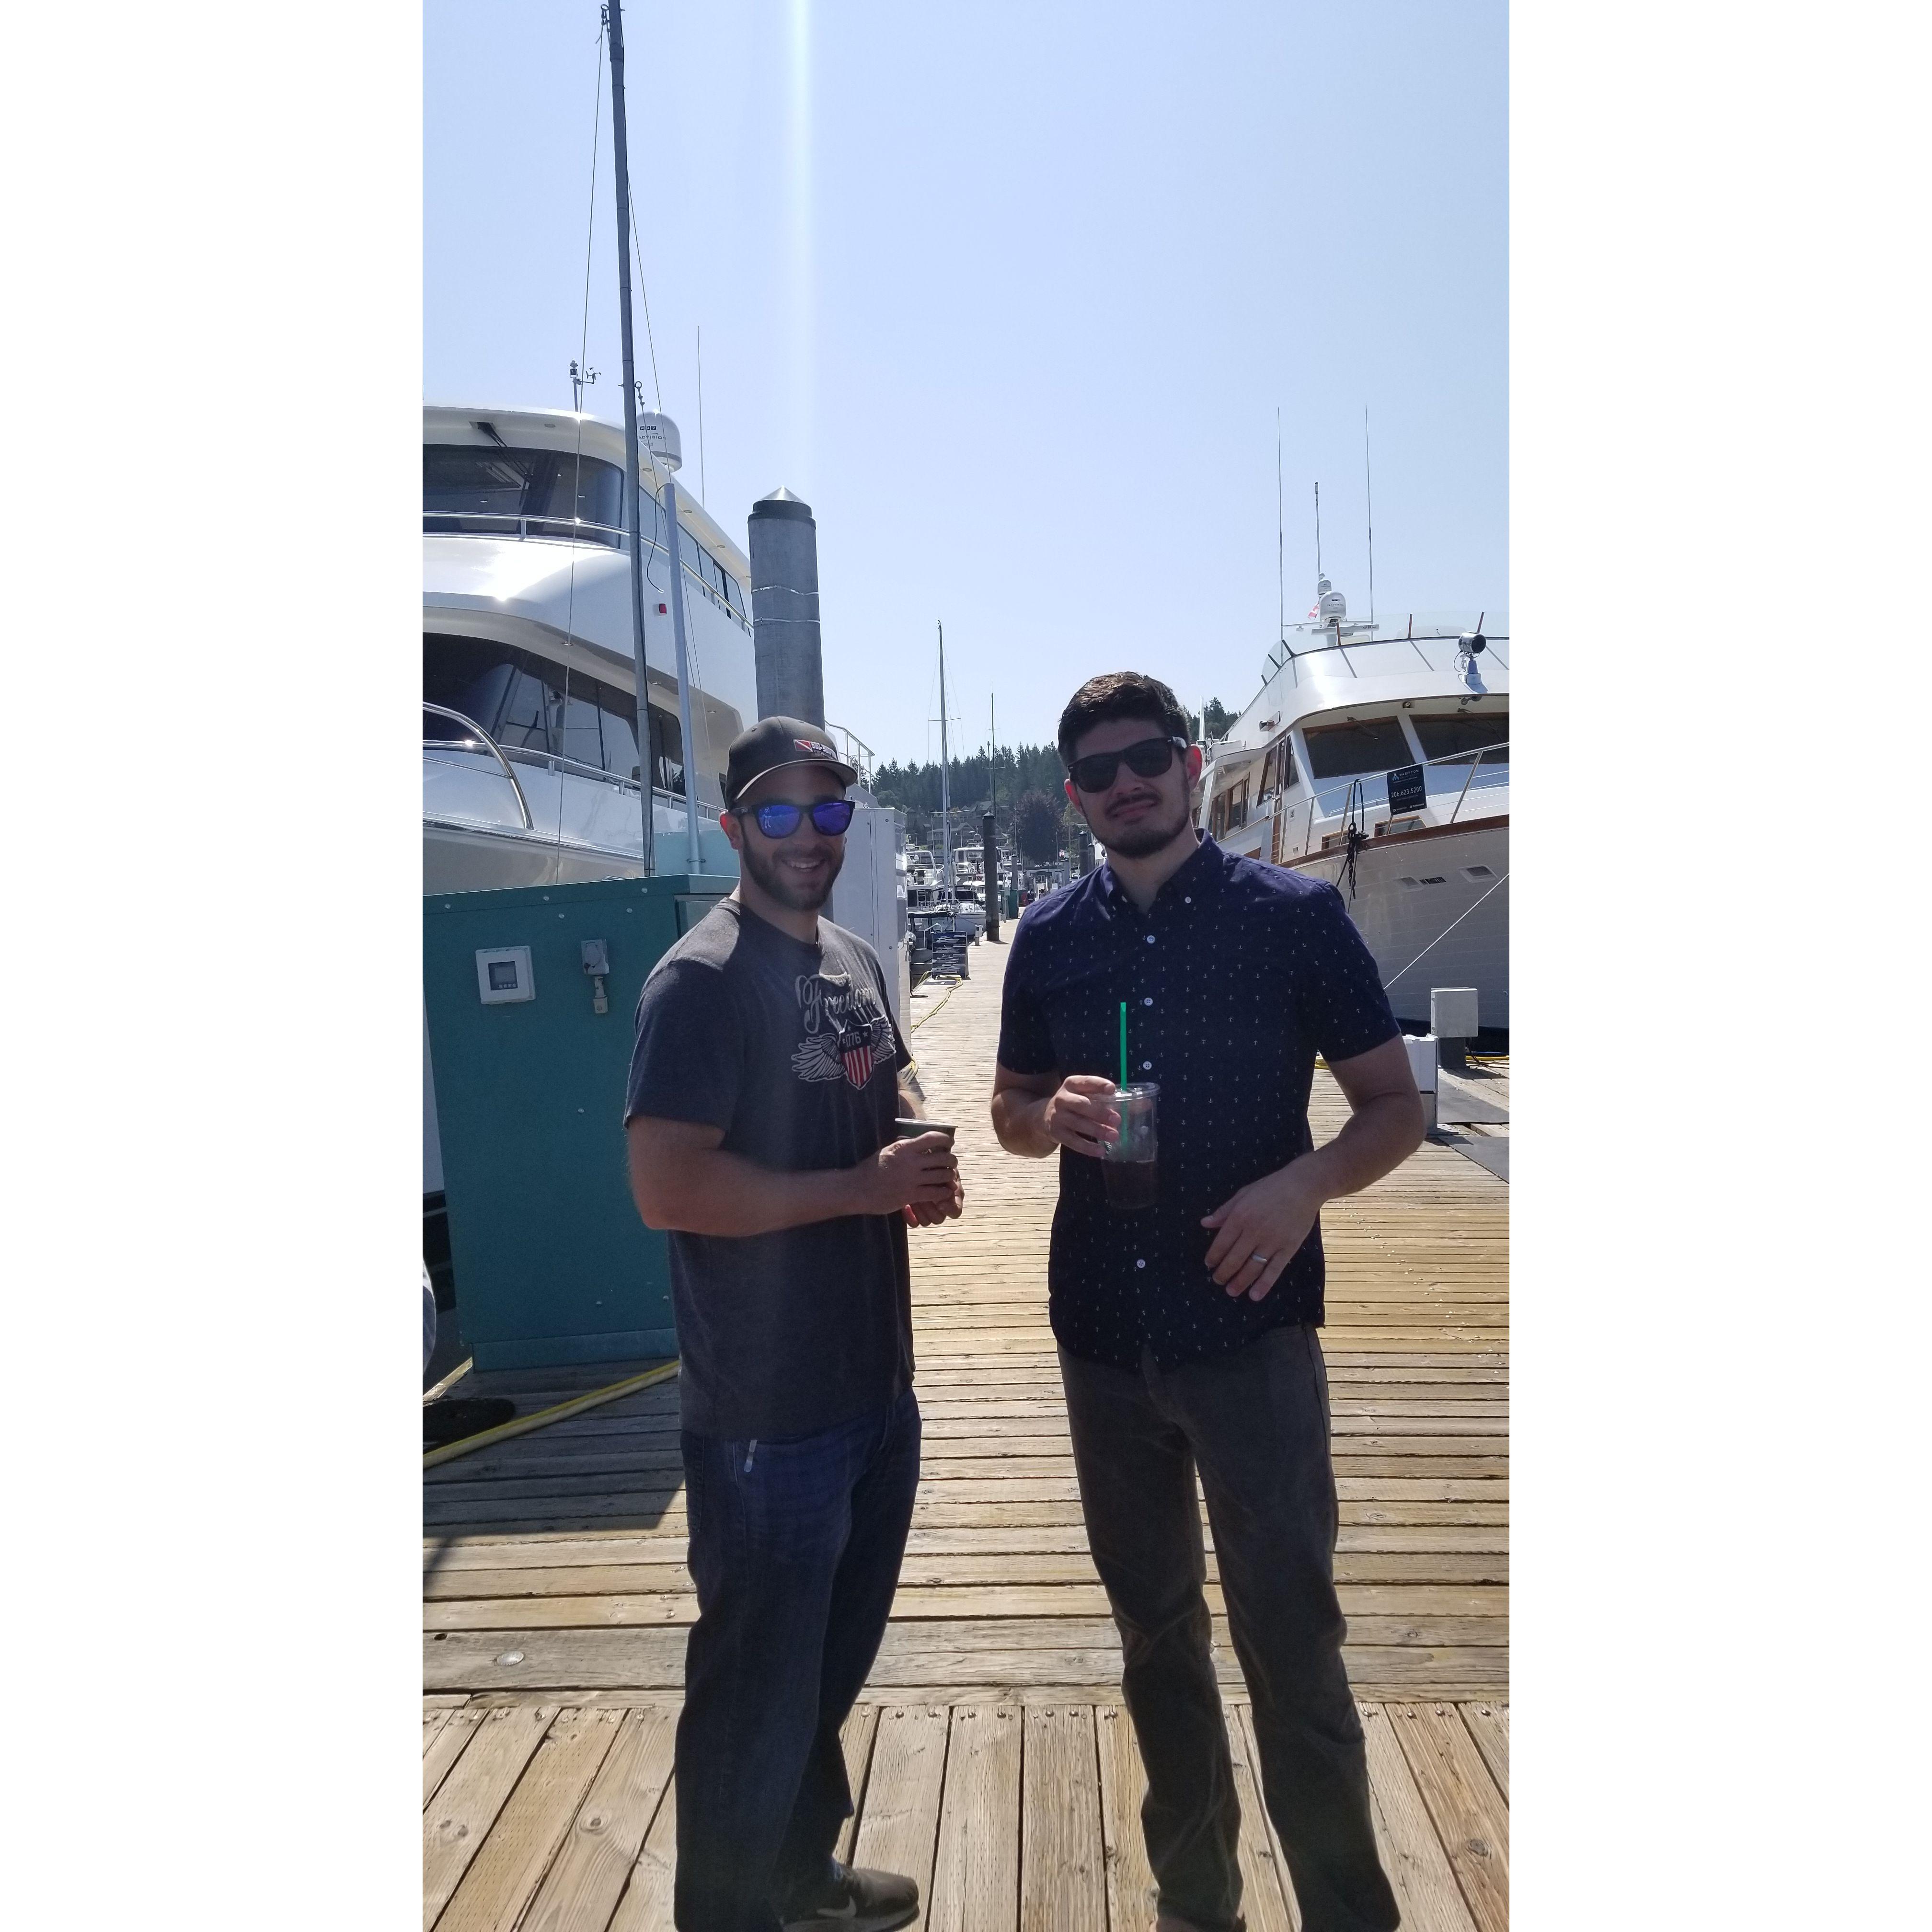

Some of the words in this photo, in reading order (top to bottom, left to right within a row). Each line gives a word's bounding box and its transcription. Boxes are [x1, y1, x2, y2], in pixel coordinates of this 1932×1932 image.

[1391, 786, 1422, 797] 206.623.5200
[795, 974, 876, 1034] Freedom
[845, 1032, 862, 1047] 1776
